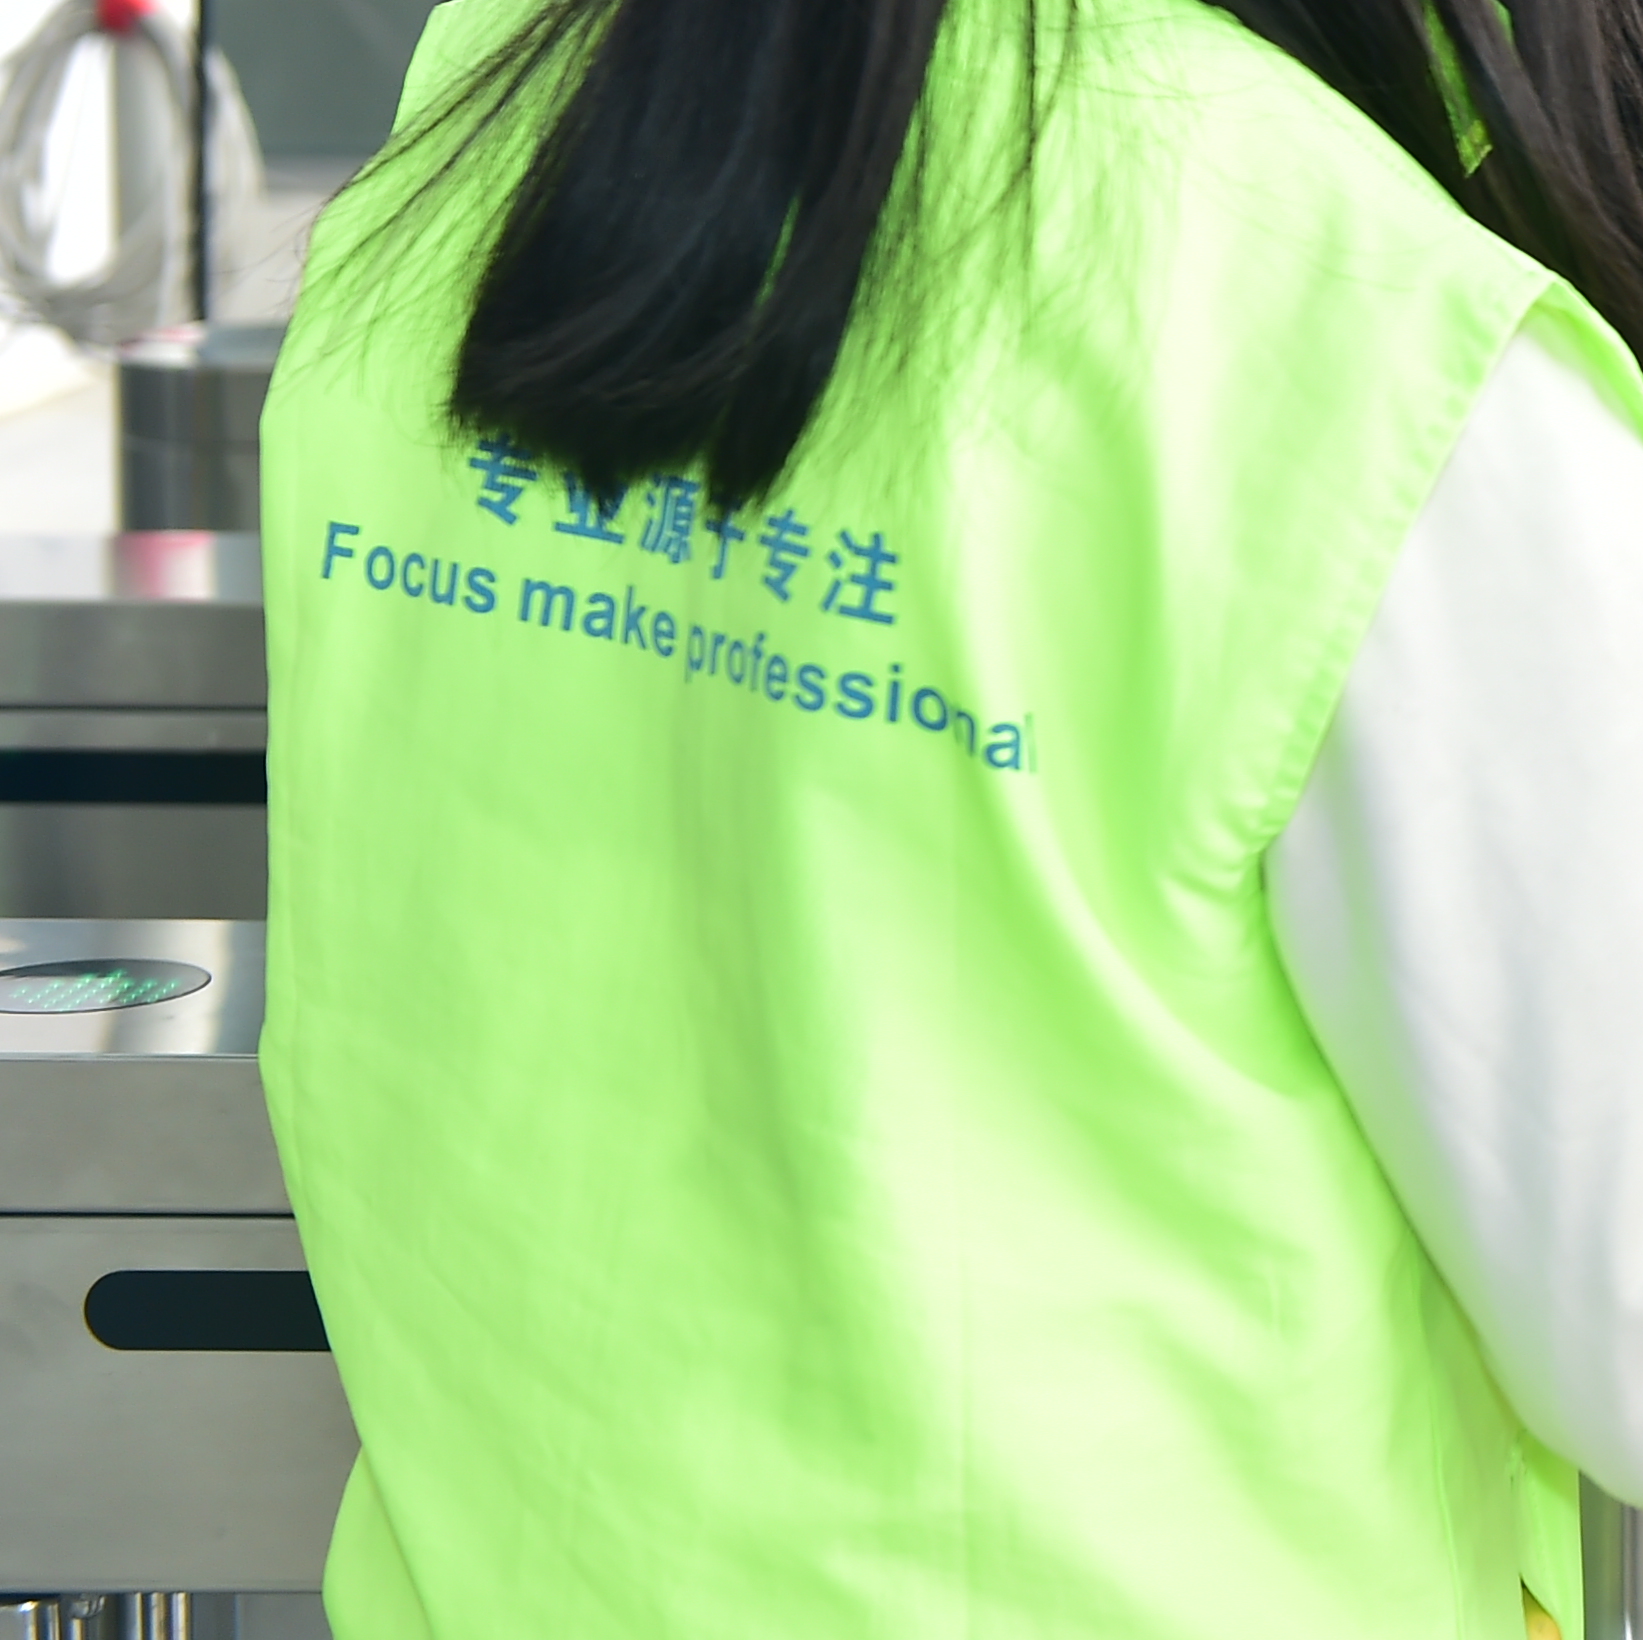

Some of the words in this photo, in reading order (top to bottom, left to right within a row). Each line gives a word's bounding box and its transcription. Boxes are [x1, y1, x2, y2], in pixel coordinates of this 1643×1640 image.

[321, 521, 497, 614] Focus
[518, 576, 676, 658] make
[684, 622, 1039, 774] professional
